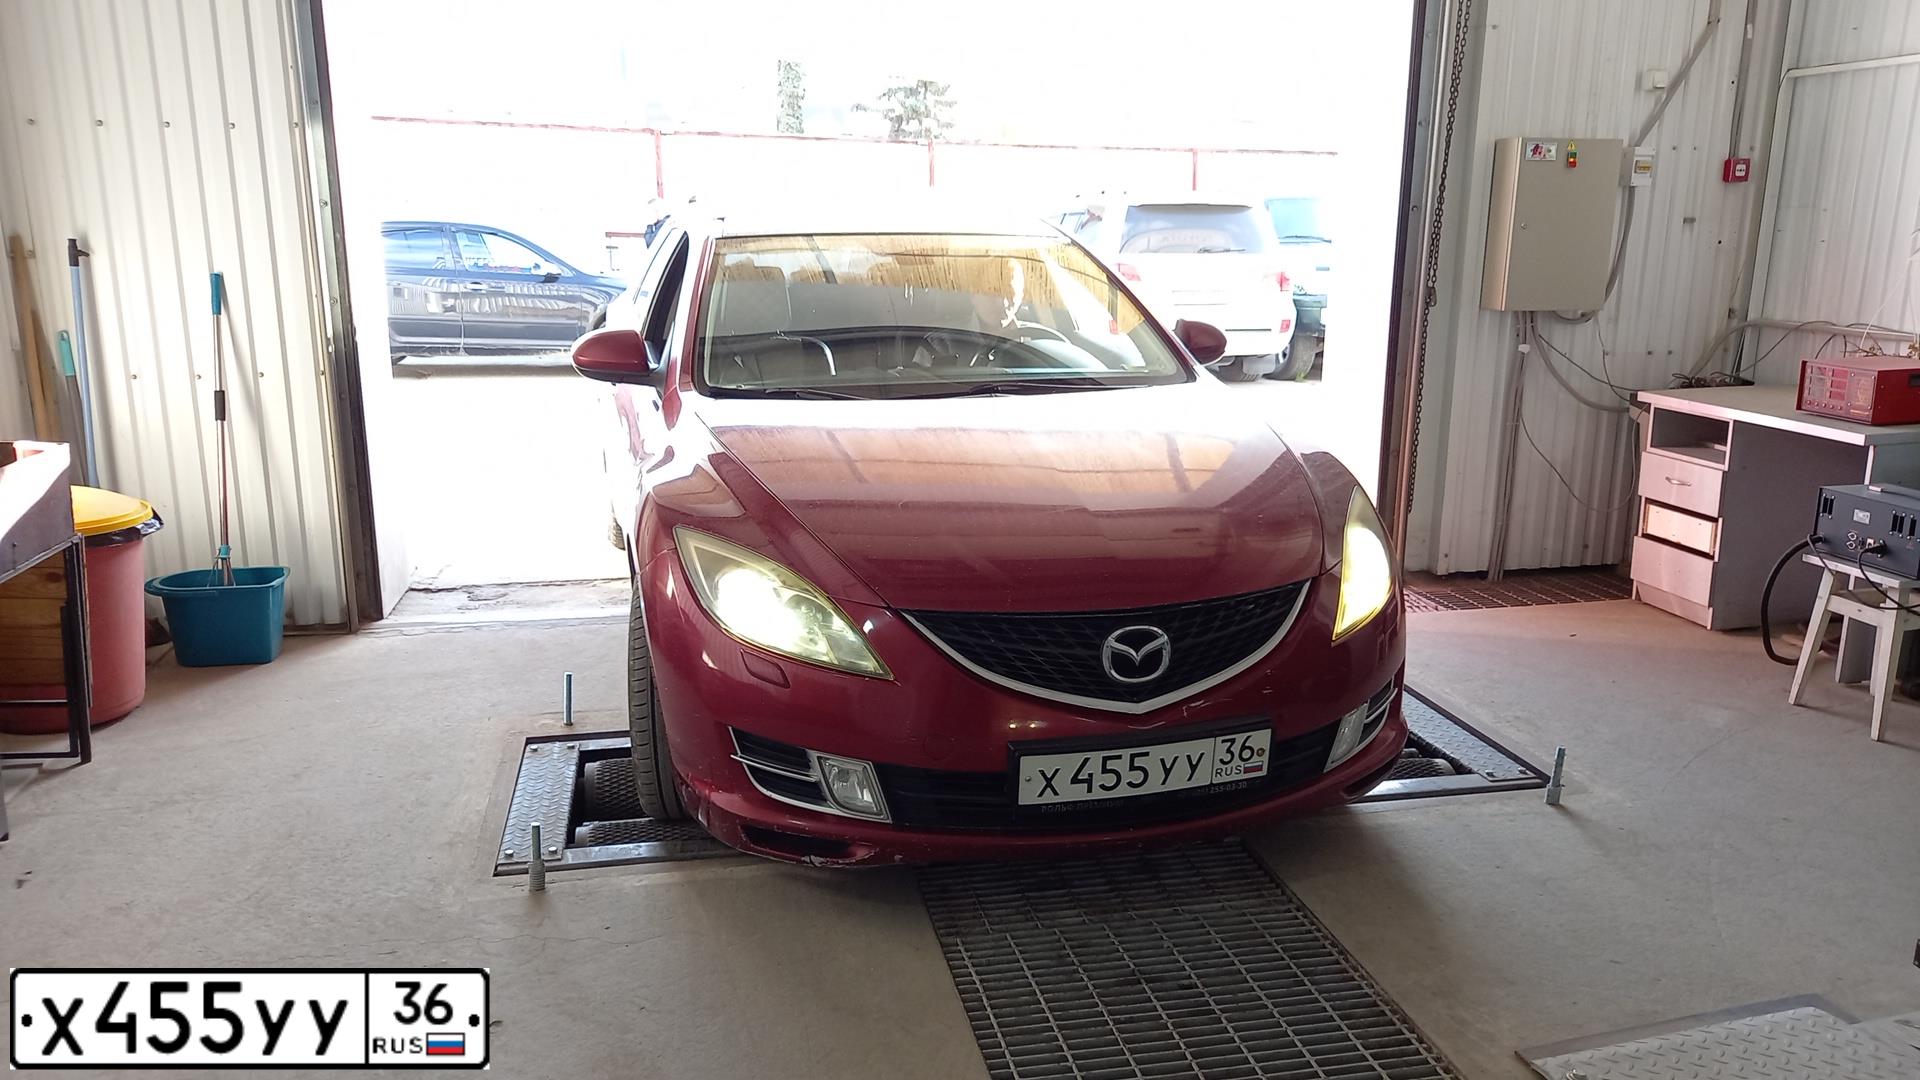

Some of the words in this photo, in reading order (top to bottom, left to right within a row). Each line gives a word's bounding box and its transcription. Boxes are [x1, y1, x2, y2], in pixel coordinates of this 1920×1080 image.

[1219, 735, 1255, 765] 36
[1036, 751, 1205, 798] Х455УУ
[1215, 764, 1242, 777] RUS
